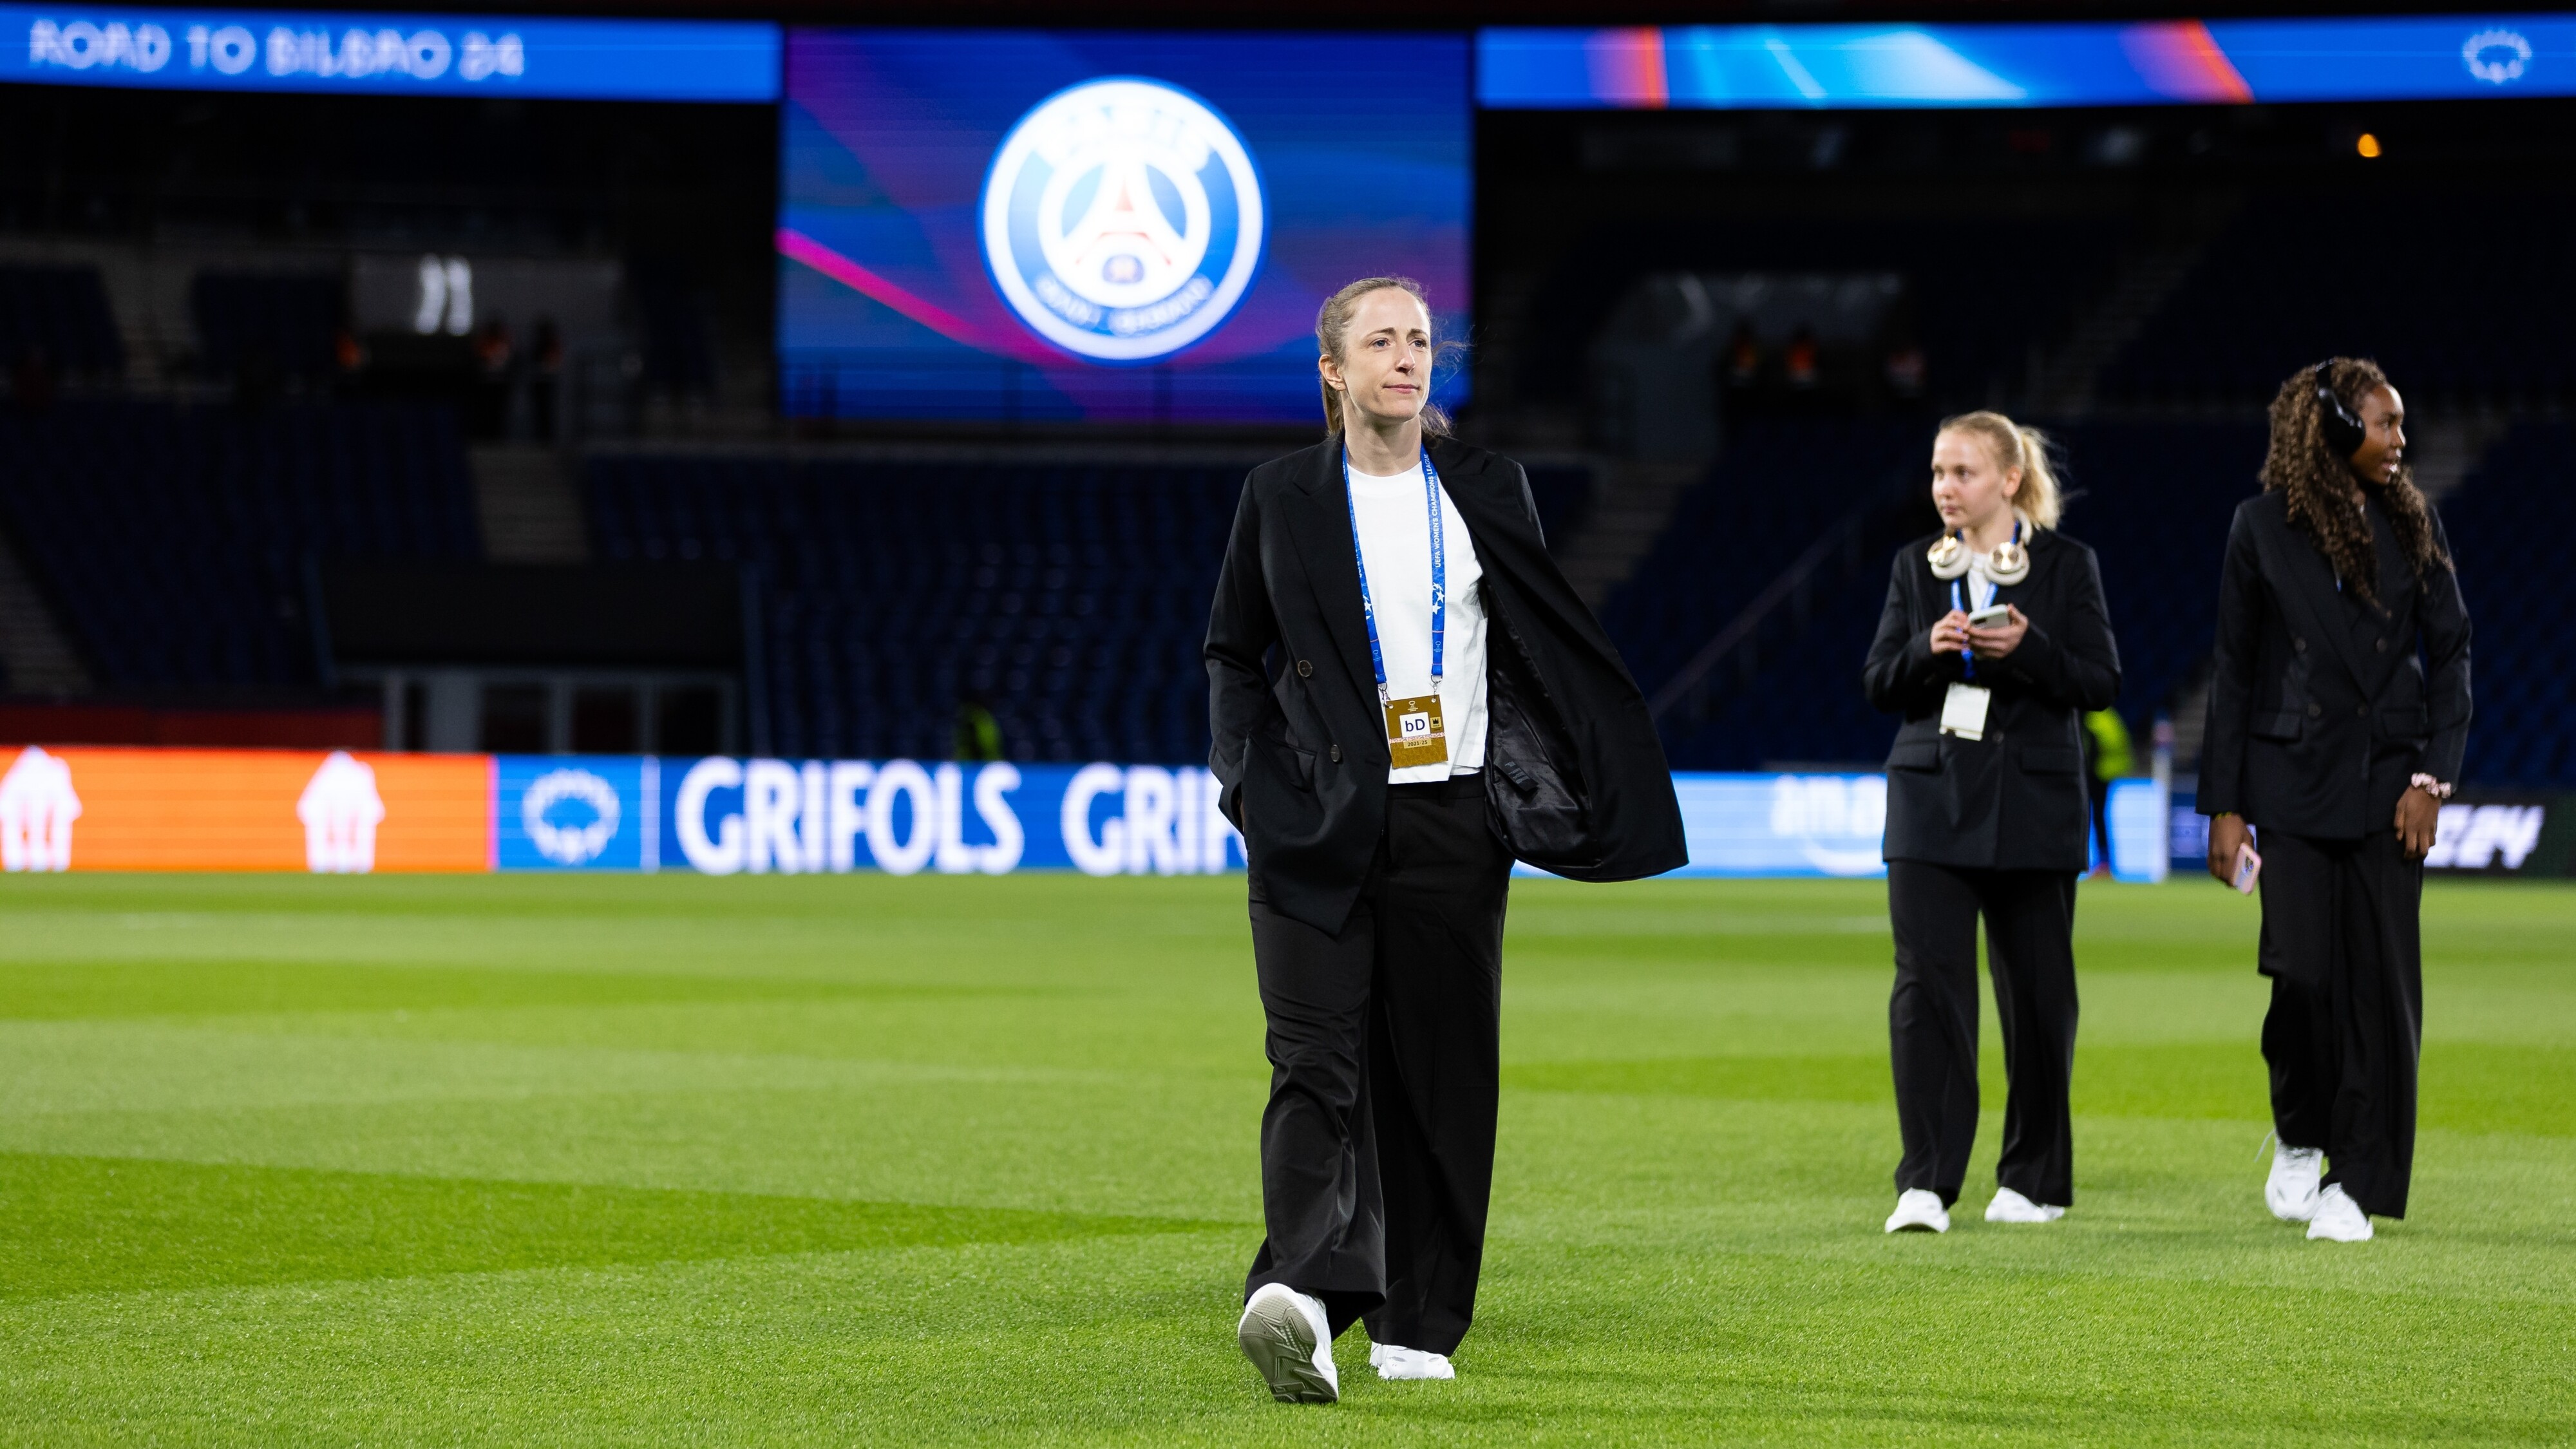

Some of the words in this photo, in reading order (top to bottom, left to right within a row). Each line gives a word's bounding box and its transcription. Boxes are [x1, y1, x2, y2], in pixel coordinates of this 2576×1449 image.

[30, 19, 171, 73] ROAD
[187, 24, 256, 75] TO
[1424, 453, 1433, 475] LEAGUE
[1428, 476, 1438, 516] CHAMPIONS
[1405, 719, 1425, 732] bD
[674, 756, 1025, 876] GRIFOLS
